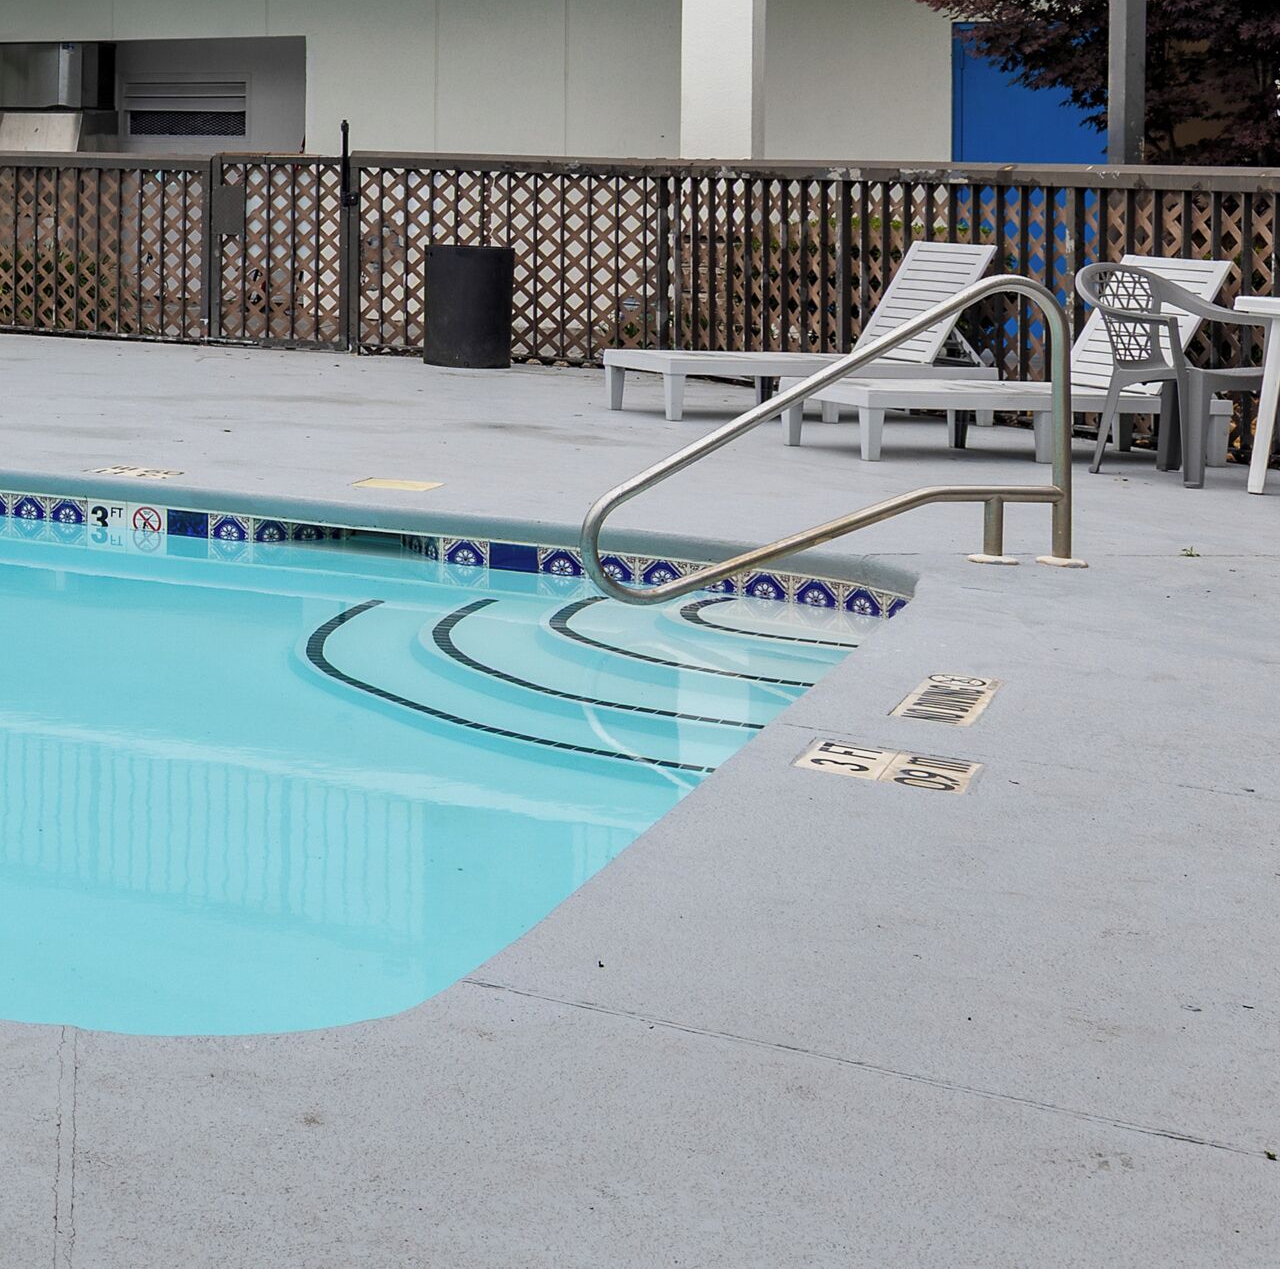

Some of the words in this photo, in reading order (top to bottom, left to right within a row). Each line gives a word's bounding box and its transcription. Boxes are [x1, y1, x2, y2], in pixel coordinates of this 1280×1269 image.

[91, 506, 108, 527] 3
[111, 507, 123, 518] FT
[913, 684, 985, 713] DIVING
[901, 707, 965, 725] NO
[818, 742, 883, 761] FT
[810, 758, 870, 772] 3
[907, 756, 973, 773] m
[894, 769, 961, 792] 0.9
